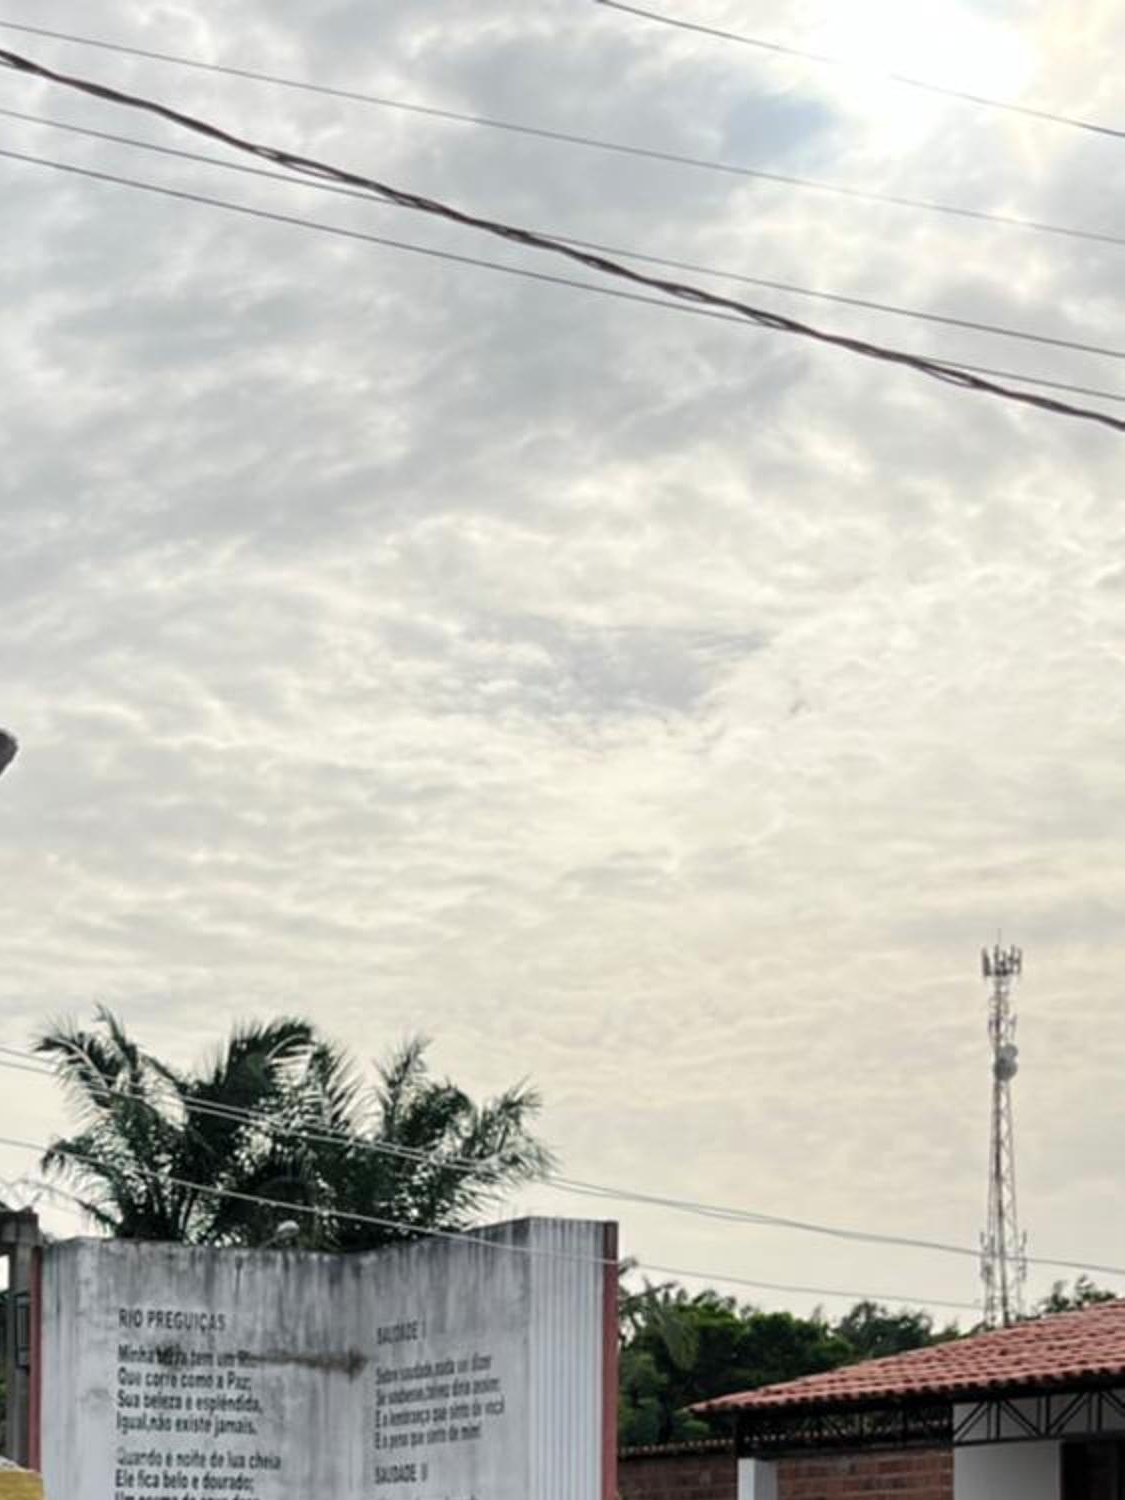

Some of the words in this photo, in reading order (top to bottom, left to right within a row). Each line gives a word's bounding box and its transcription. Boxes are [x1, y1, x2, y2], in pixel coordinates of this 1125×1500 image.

[119, 1309, 143, 1328] RIO
[147, 1310, 226, 1332] PREGUIÇAS
[180, 1374, 213, 1388] como
[117, 1388, 139, 1408] Sua
[210, 1450, 224, 1468] de
[116, 1468, 134, 1488] Ele
[137, 1469, 159, 1488] fica
[162, 1470, 188, 1489] belo
